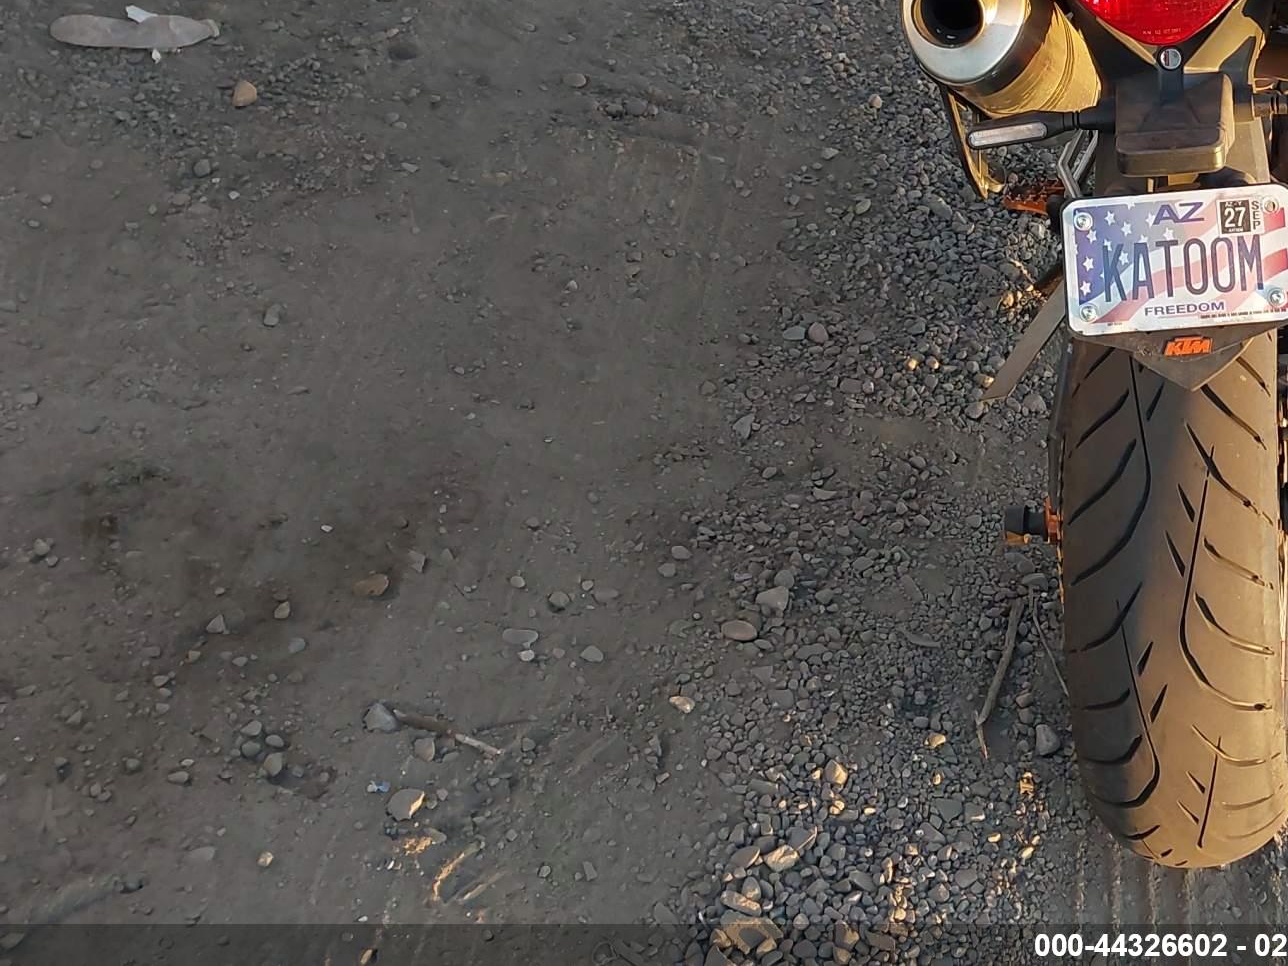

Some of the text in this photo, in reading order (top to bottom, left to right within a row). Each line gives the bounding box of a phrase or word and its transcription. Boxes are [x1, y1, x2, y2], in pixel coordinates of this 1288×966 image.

[1152, 201, 1205, 226] AZ
[1224, 206, 1246, 228] 27
[1251, 200, 1261, 230] SEP
[1101, 234, 1265, 303] KATOOM
[1144, 301, 1225, 317] FREEDOM
[1164, 336, 1211, 356] KTM
